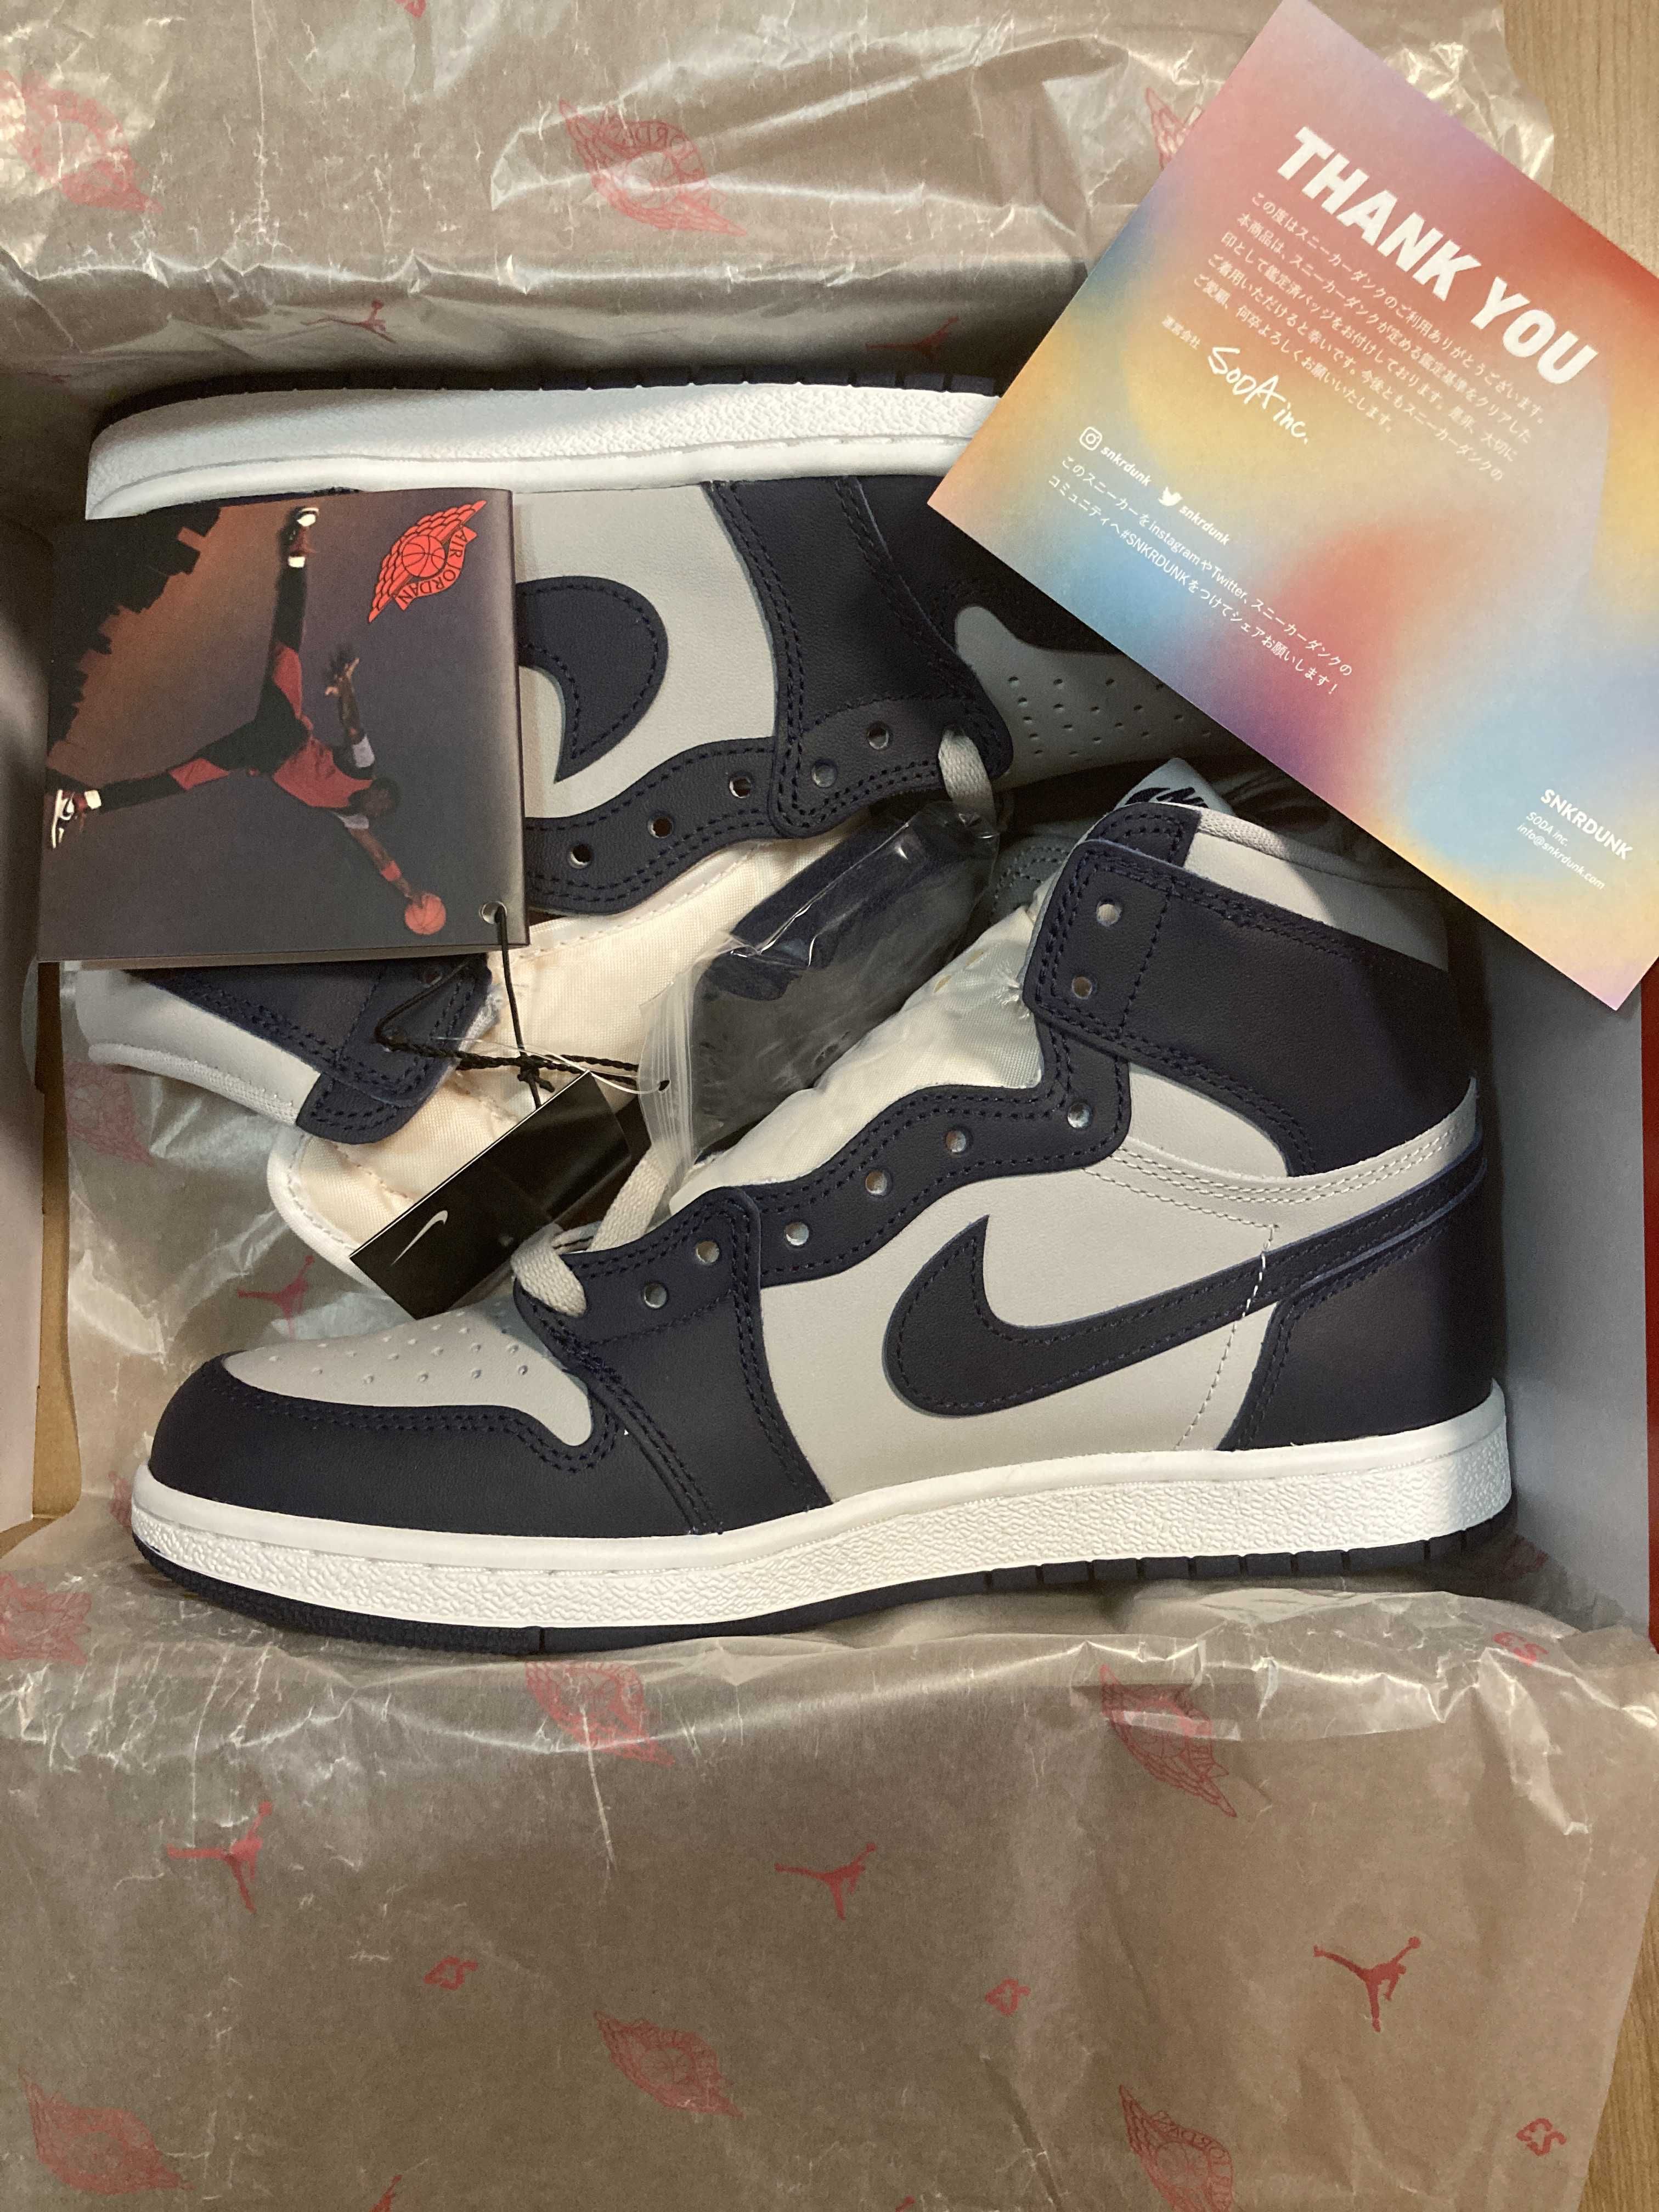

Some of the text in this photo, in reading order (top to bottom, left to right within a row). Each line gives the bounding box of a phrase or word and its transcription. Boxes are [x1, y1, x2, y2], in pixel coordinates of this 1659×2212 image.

[1277, 126, 1599, 385] THANK YOU
[1101, 447, 1229, 545] snkrdunk snkrdunk
[397, 529, 469, 605] AIR JORDAN
[1517, 823, 1605, 890] info@snkrdunk.com
[1526, 811, 1554, 834] SODA
[1541, 789, 1633, 860] SNKRDUNK
